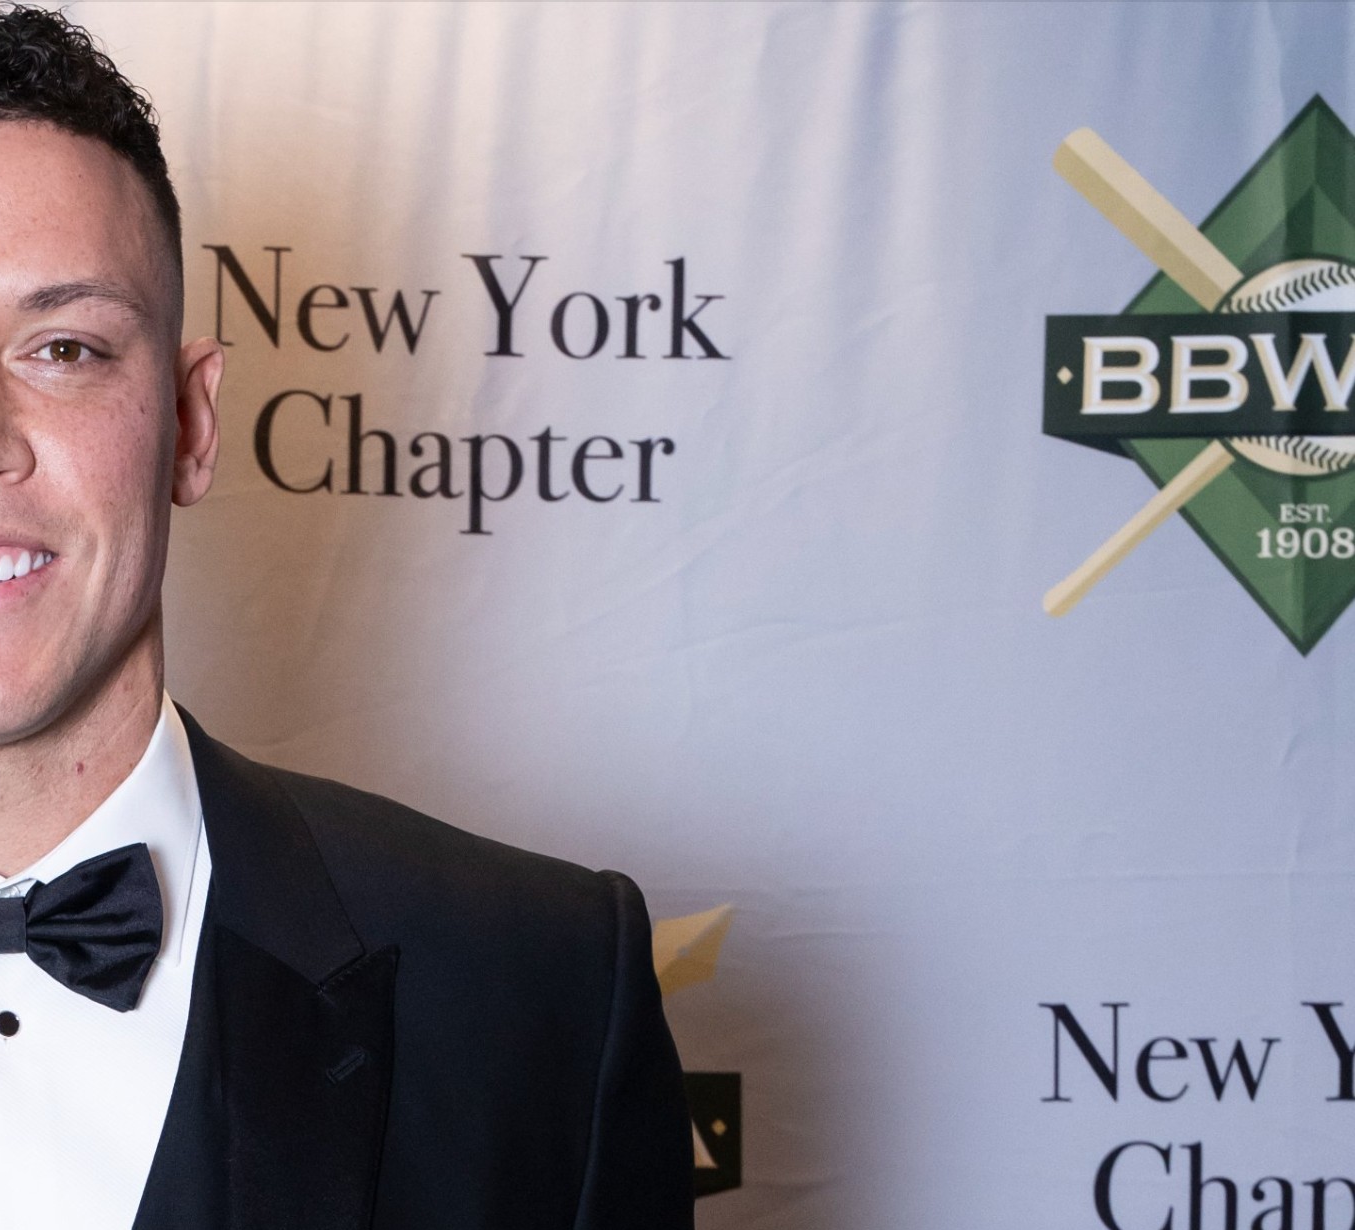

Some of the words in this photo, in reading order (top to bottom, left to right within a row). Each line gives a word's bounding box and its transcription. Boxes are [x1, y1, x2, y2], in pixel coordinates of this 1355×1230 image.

[201, 243, 440, 355] New
[461, 253, 731, 361] York
[253, 389, 675, 535] Chapter
[1256, 527, 1355, 559] 1908
[1279, 504, 1333, 523] EST.
[1038, 1002, 1281, 1102] New
